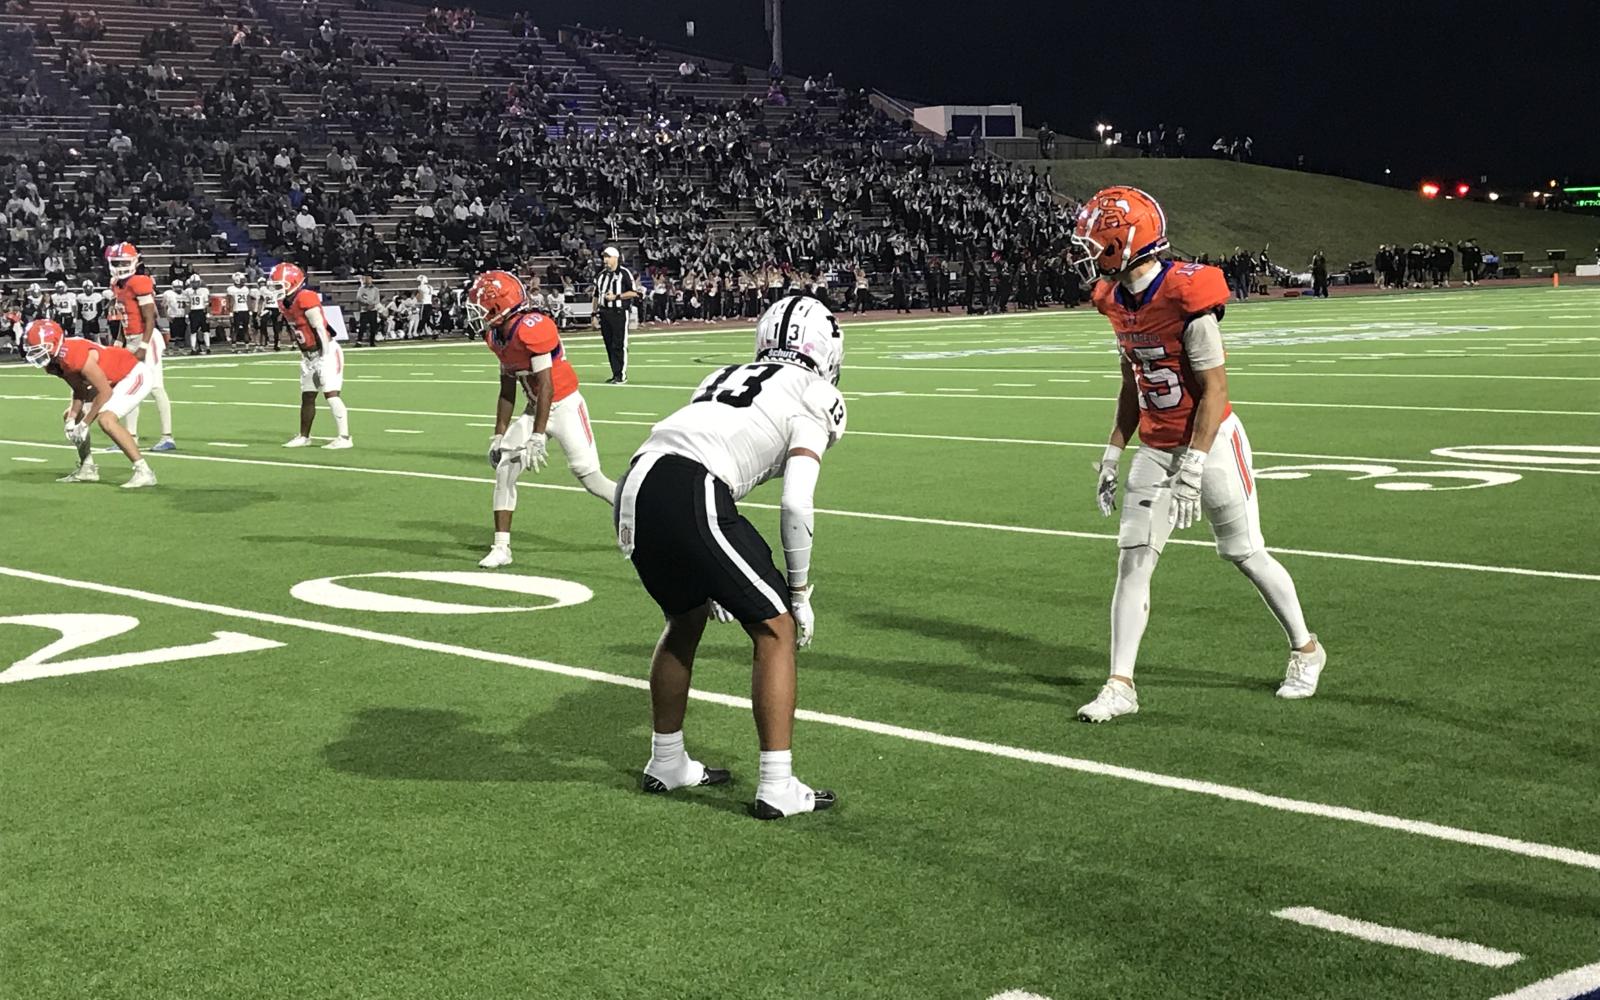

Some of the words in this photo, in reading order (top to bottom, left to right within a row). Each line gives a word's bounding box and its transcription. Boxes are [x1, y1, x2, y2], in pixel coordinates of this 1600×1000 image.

[83, 302, 93, 312] 24
[192, 296, 201, 306] 19
[691, 364, 784, 408] 13
[1132, 346, 1182, 410] 15
[829, 398, 844, 425] 13
